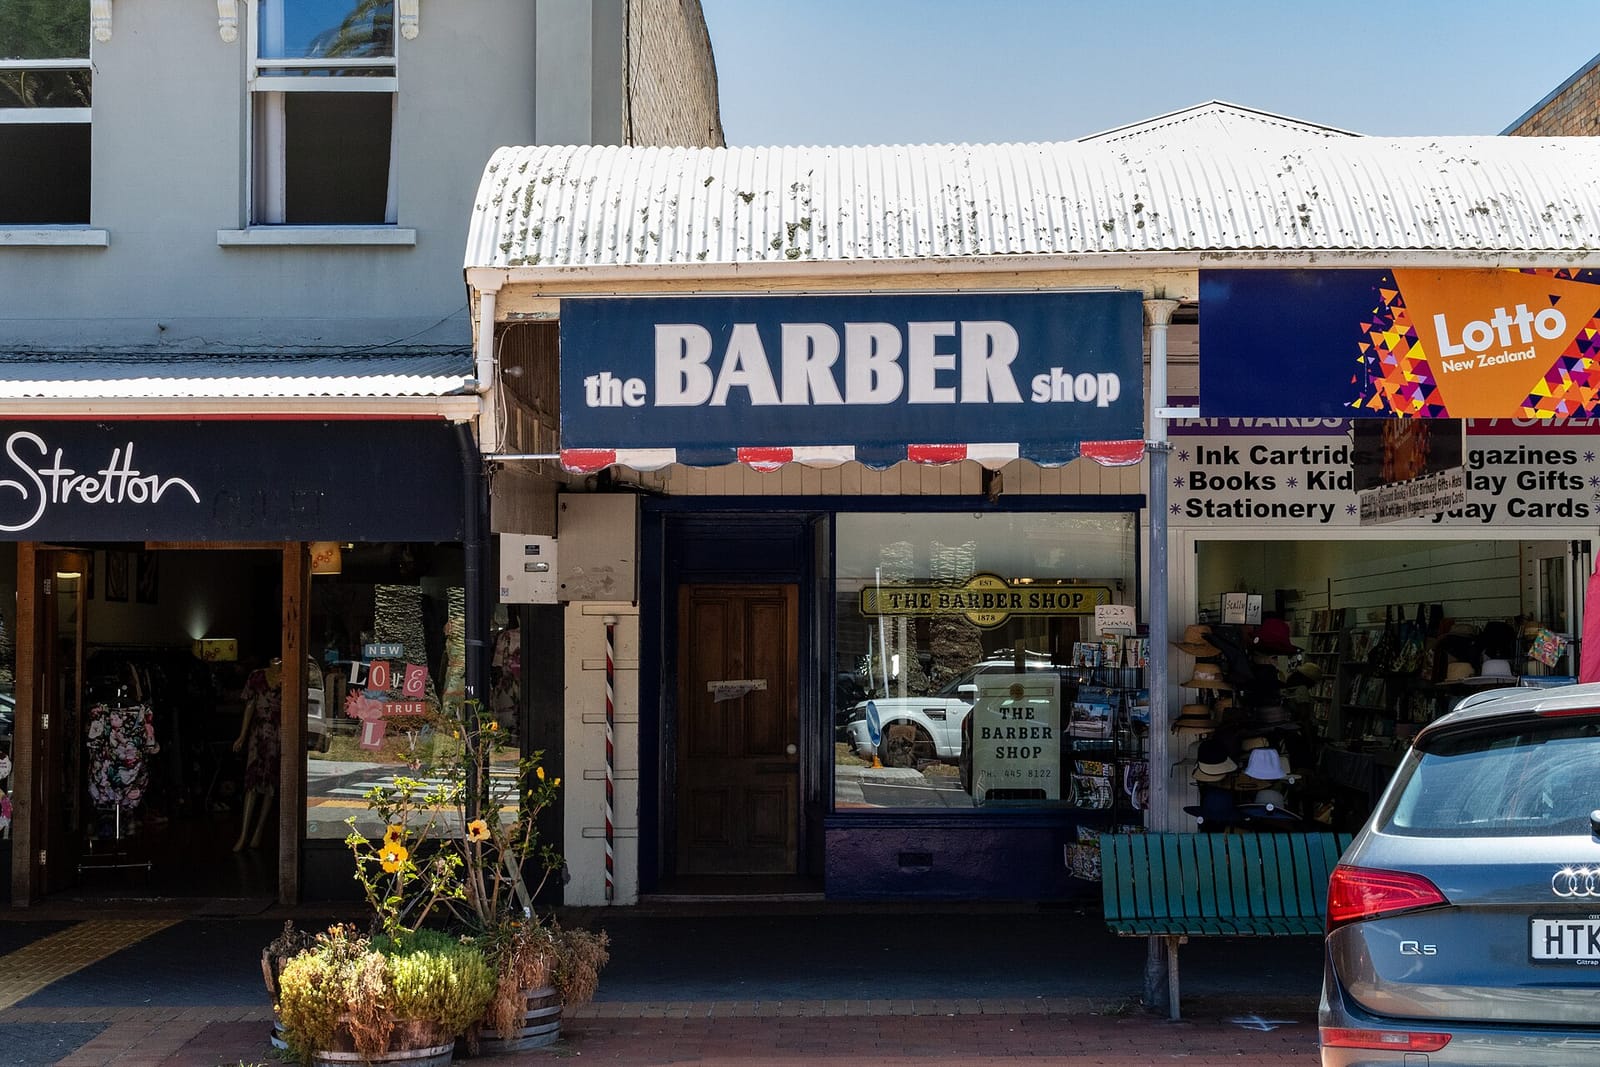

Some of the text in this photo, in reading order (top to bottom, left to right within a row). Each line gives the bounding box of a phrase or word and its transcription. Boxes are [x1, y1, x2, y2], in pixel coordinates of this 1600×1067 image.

[1433, 303, 1567, 357] Lotto
[584, 319, 1121, 407] the BARBER shop
[1441, 346, 1536, 373] New Zealand
[1196, 445, 1578, 470] Ink Cartrid gazines
[0, 431, 200, 531] Stretton
[1189, 471, 1277, 490] Books
[1307, 470, 1353, 490] Kid
[1516, 470, 1584, 490] Gifts
[1185, 497, 1335, 523] Stationery
[1507, 497, 1590, 518] Cards
[889, 592, 1084, 609] THE BARBER SHOP
[369, 646, 400, 655] NEW
[386, 704, 422, 713] TRUE
[1000, 707, 1035, 720] THE
[981, 727, 1053, 739] BARBER
[995, 746, 1042, 759] SHOP
[1004, 769, 1022, 777] 445
[1028, 769, 1051, 778] 8122
[1399, 940, 1437, 955] Q5
[1545, 925, 1600, 954] HTK
